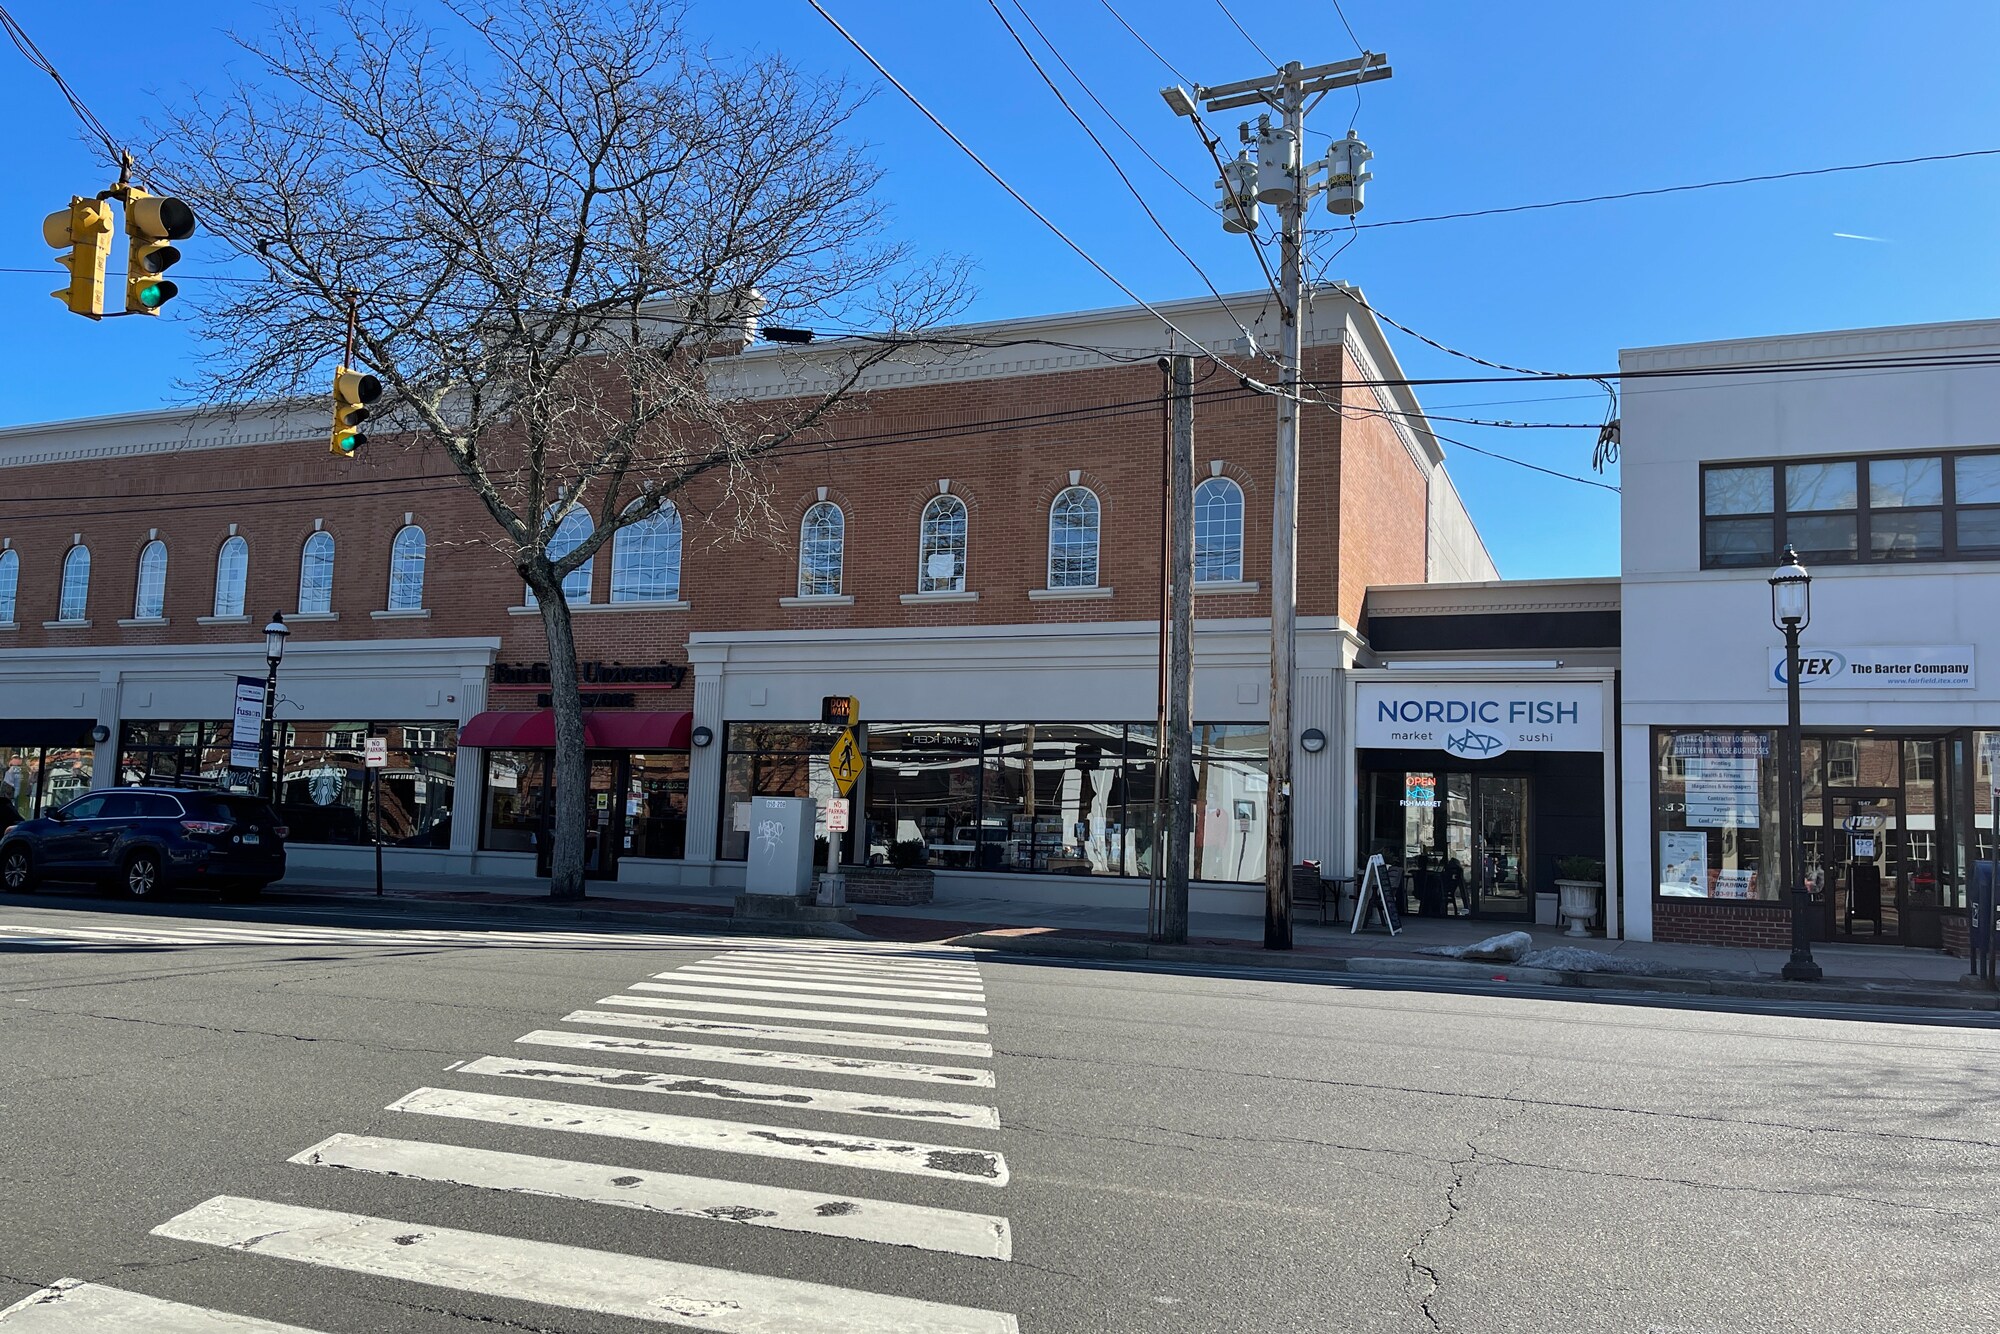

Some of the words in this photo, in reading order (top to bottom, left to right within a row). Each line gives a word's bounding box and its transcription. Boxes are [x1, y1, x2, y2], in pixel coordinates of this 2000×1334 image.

[1796, 658, 1834, 675] TEX
[1851, 663, 1872, 674] The
[1875, 663, 1911, 674] Barter
[1914, 662, 1969, 675] Company
[582, 661, 688, 690] University
[1378, 700, 1499, 723] NORDIC
[1509, 701, 1578, 724] FISH
[1391, 731, 1433, 741] market
[1518, 732, 1553, 742] sushi
[1733, 747, 1769, 755] BUSINESSES
[1406, 777, 1436, 786] OPEN
[1415, 800, 1442, 808] MARKET
[828, 808, 847, 816] PARKING
[1850, 815, 1878, 827] ITEX
